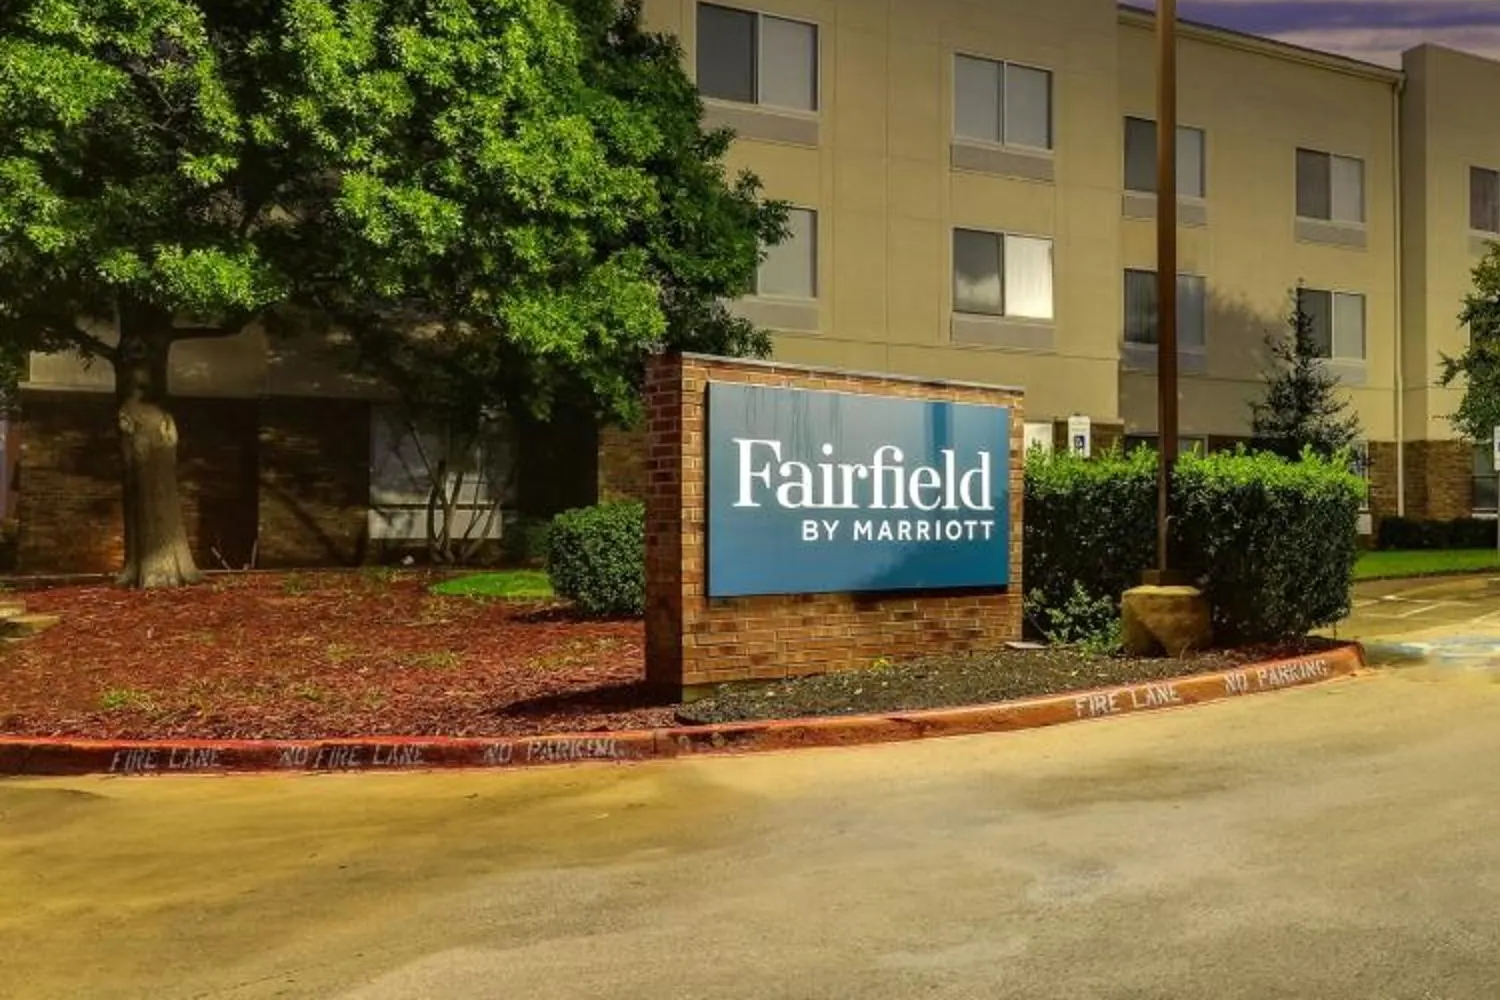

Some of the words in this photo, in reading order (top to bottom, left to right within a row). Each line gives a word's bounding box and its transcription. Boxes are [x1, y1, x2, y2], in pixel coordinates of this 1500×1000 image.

[733, 437, 995, 511] Fairfield
[802, 520, 840, 541] BY
[853, 520, 995, 541] MARRIOTT
[1075, 692, 1120, 717] FIRE
[1131, 682, 1181, 708] LANE
[1224, 671, 1247, 695] NO
[1258, 659, 1327, 687] PARKING
[110, 748, 157, 771] FIRE
[169, 747, 221, 769] LANE
[278, 746, 308, 767] NO
[313, 746, 361, 768] FIRE
[372, 743, 426, 765] LANE
[483, 743, 513, 765] NO
